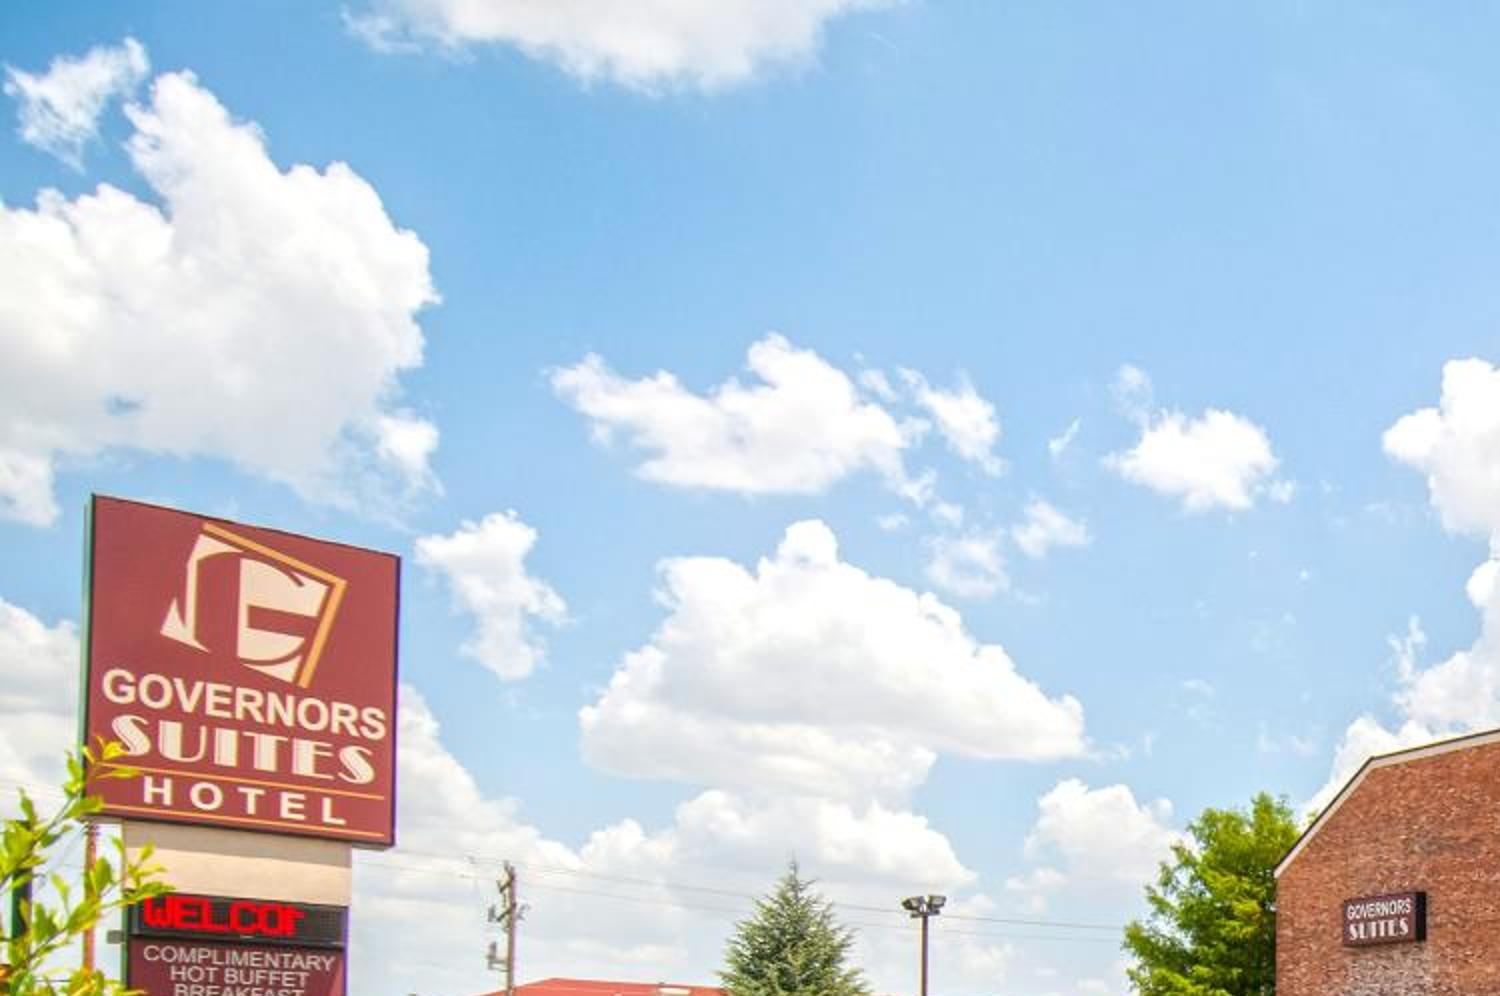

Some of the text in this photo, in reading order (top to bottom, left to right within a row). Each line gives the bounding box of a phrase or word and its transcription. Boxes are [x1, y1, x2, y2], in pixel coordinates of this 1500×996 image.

[102, 668, 387, 741] GOVERNORS
[111, 714, 376, 785] SUITES
[143, 776, 347, 826] HOTEL
[1347, 898, 1411, 920] GOVERNORS
[1349, 918, 1409, 941] SUITES
[143, 945, 336, 972] COMPLIMENTARY
[170, 966, 310, 989] HOT BUFFET
